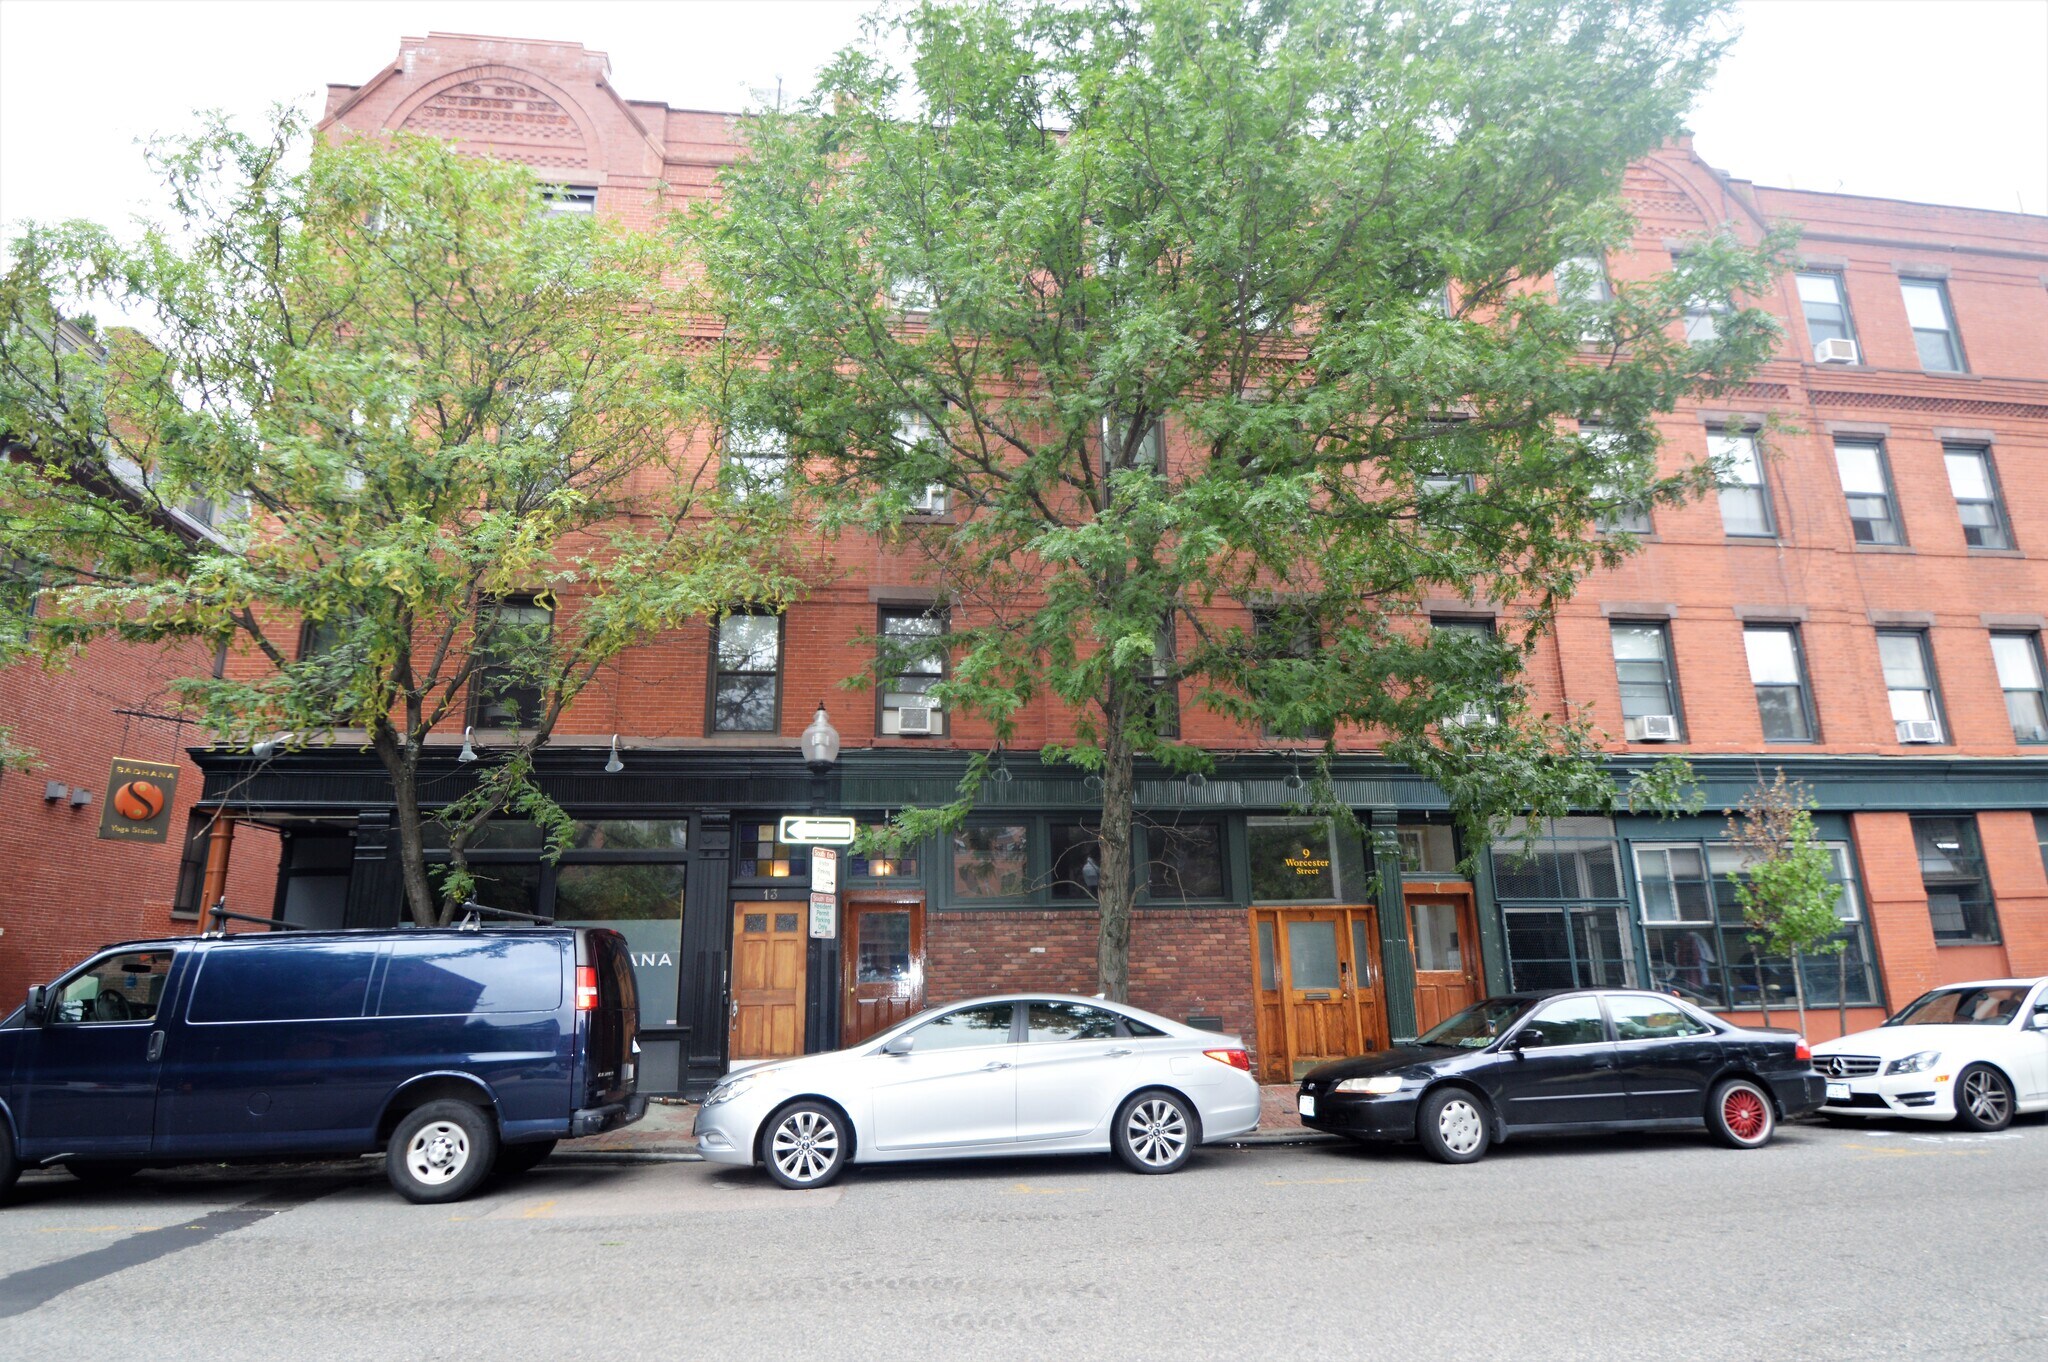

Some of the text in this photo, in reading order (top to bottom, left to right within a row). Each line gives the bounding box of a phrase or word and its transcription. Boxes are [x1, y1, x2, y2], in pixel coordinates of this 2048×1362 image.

[116, 766, 174, 779] SADHANA
[111, 825, 158, 835] Yoga Studio
[1302, 848, 1310, 859] 9
[1285, 858, 1329, 867] Worcester
[1296, 867, 1319, 875] Street
[1432, 882, 1440, 894] 7
[763, 888, 778, 900] 13
